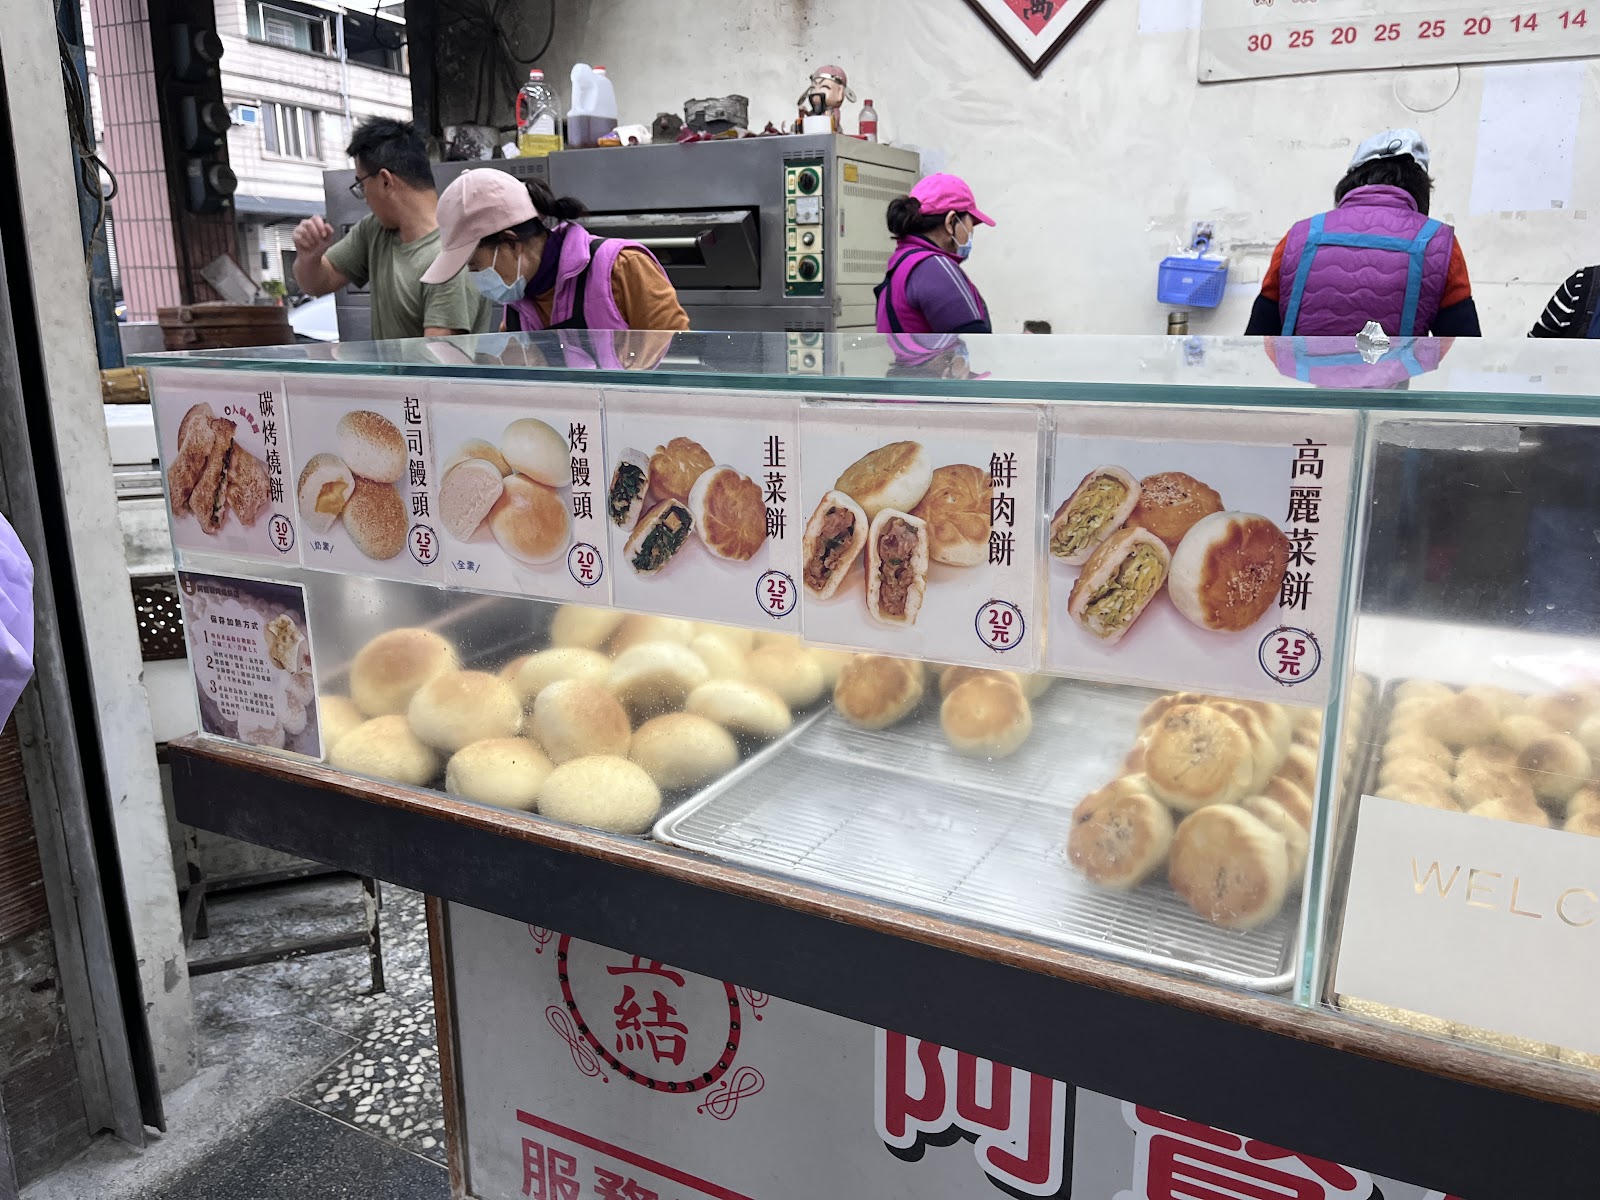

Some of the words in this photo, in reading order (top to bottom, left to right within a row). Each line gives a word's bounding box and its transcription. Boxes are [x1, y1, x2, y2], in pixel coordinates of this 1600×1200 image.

[1247, 33, 1272, 52] 30
[1288, 30, 1314, 48] 25
[1331, 27, 1357, 45] 20
[1374, 23, 1401, 42] 25
[1418, 20, 1445, 39] 25
[1463, 17, 1491, 36] 20
[1510, 13, 1538, 33] 14
[1558, 9, 1587, 29] 14
[257, 390, 285, 504] 碳烤燒餅
[403, 396, 430, 518] 起司饅頭
[568, 422, 593, 520] 烤饅頭
[763, 435, 788, 540] 韭菜餅
[988, 451, 1018, 567] 鮮肉餅
[274, 521, 288, 534] 30
[1278, 438, 1328, 611] 高麗菜餅
[277, 533, 288, 546] 元
[415, 531, 431, 545] 25
[418, 545, 431, 559] 元
[577, 551, 594, 566] 20
[580, 565, 593, 580] 元
[767, 578, 788, 595] 25
[769, 594, 785, 610] 元
[988, 609, 1013, 627] 20
[991, 625, 1010, 643] 元
[1275, 637, 1306, 657] 25
[206, 655, 214, 669] 2
[1278, 655, 1301, 676] 元
[210, 680, 217, 693] 3
